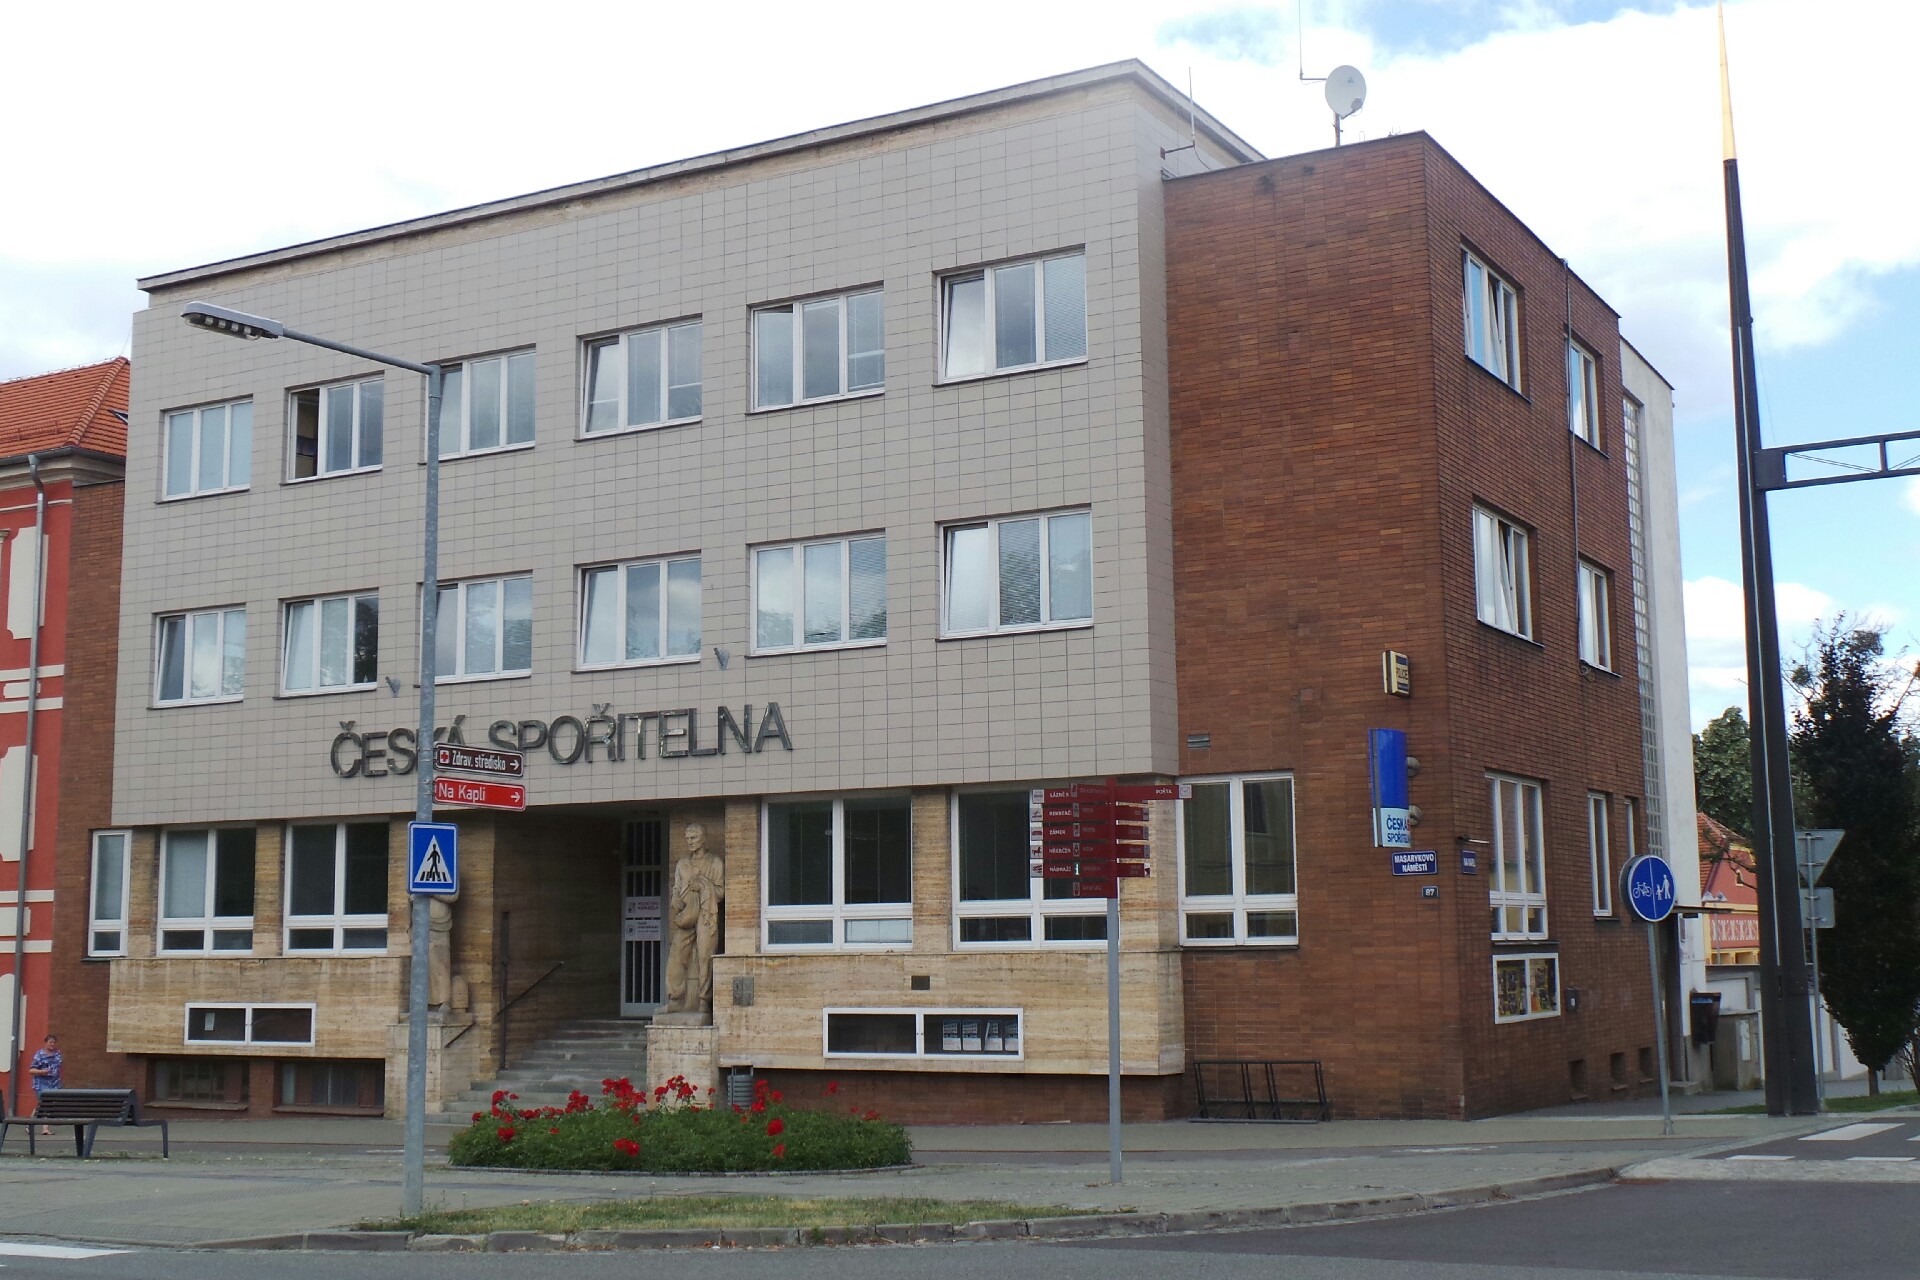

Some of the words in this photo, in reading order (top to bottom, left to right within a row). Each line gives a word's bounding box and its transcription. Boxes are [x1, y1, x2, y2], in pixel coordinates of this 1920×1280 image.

[488, 702, 793, 764] SPOŘITELNA
[452, 750, 474, 767] Zdrav.
[474, 753, 506, 771] středisko
[438, 783, 454, 799] Na
[458, 785, 486, 803] Kapli
[1394, 853, 1435, 864] MASARYKOVO
[1402, 862, 1428, 873] NÁMĚSTÍ
